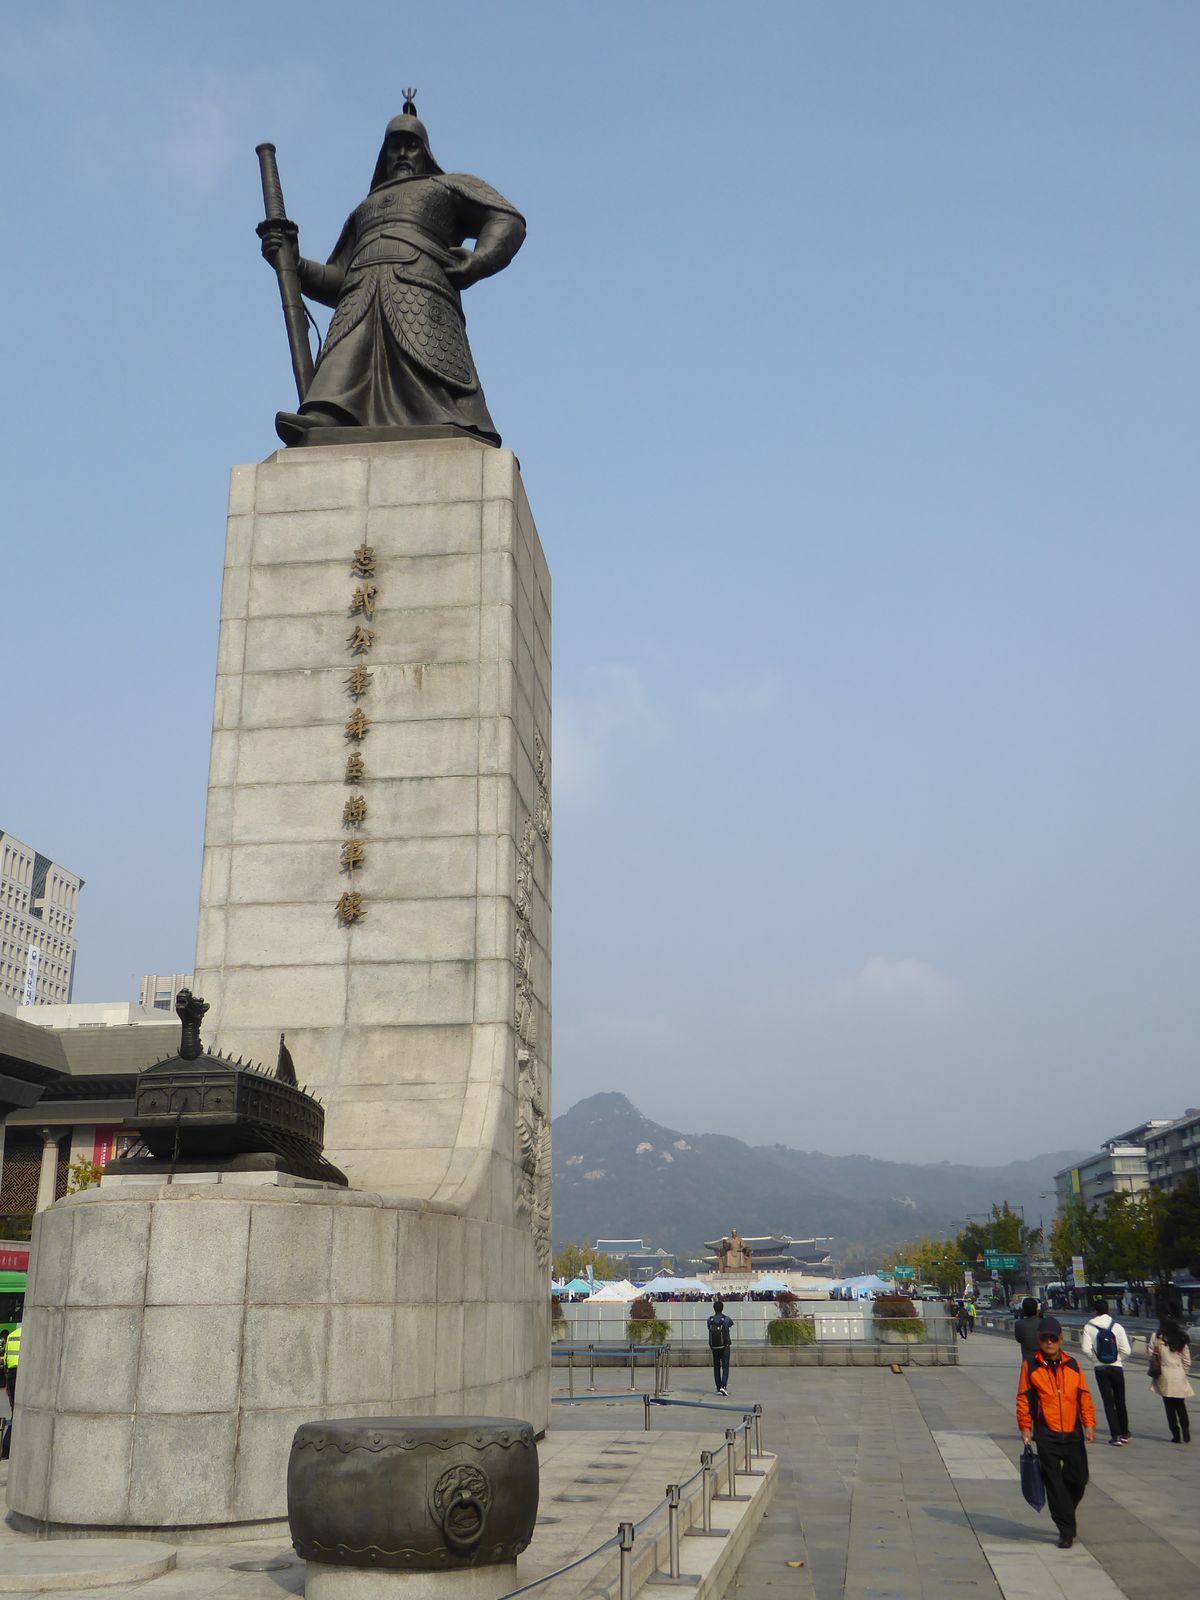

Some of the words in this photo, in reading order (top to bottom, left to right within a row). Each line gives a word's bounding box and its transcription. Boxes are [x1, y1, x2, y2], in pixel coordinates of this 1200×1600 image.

[335, 543, 377, 922] 忠武公李舜臣將軍像
